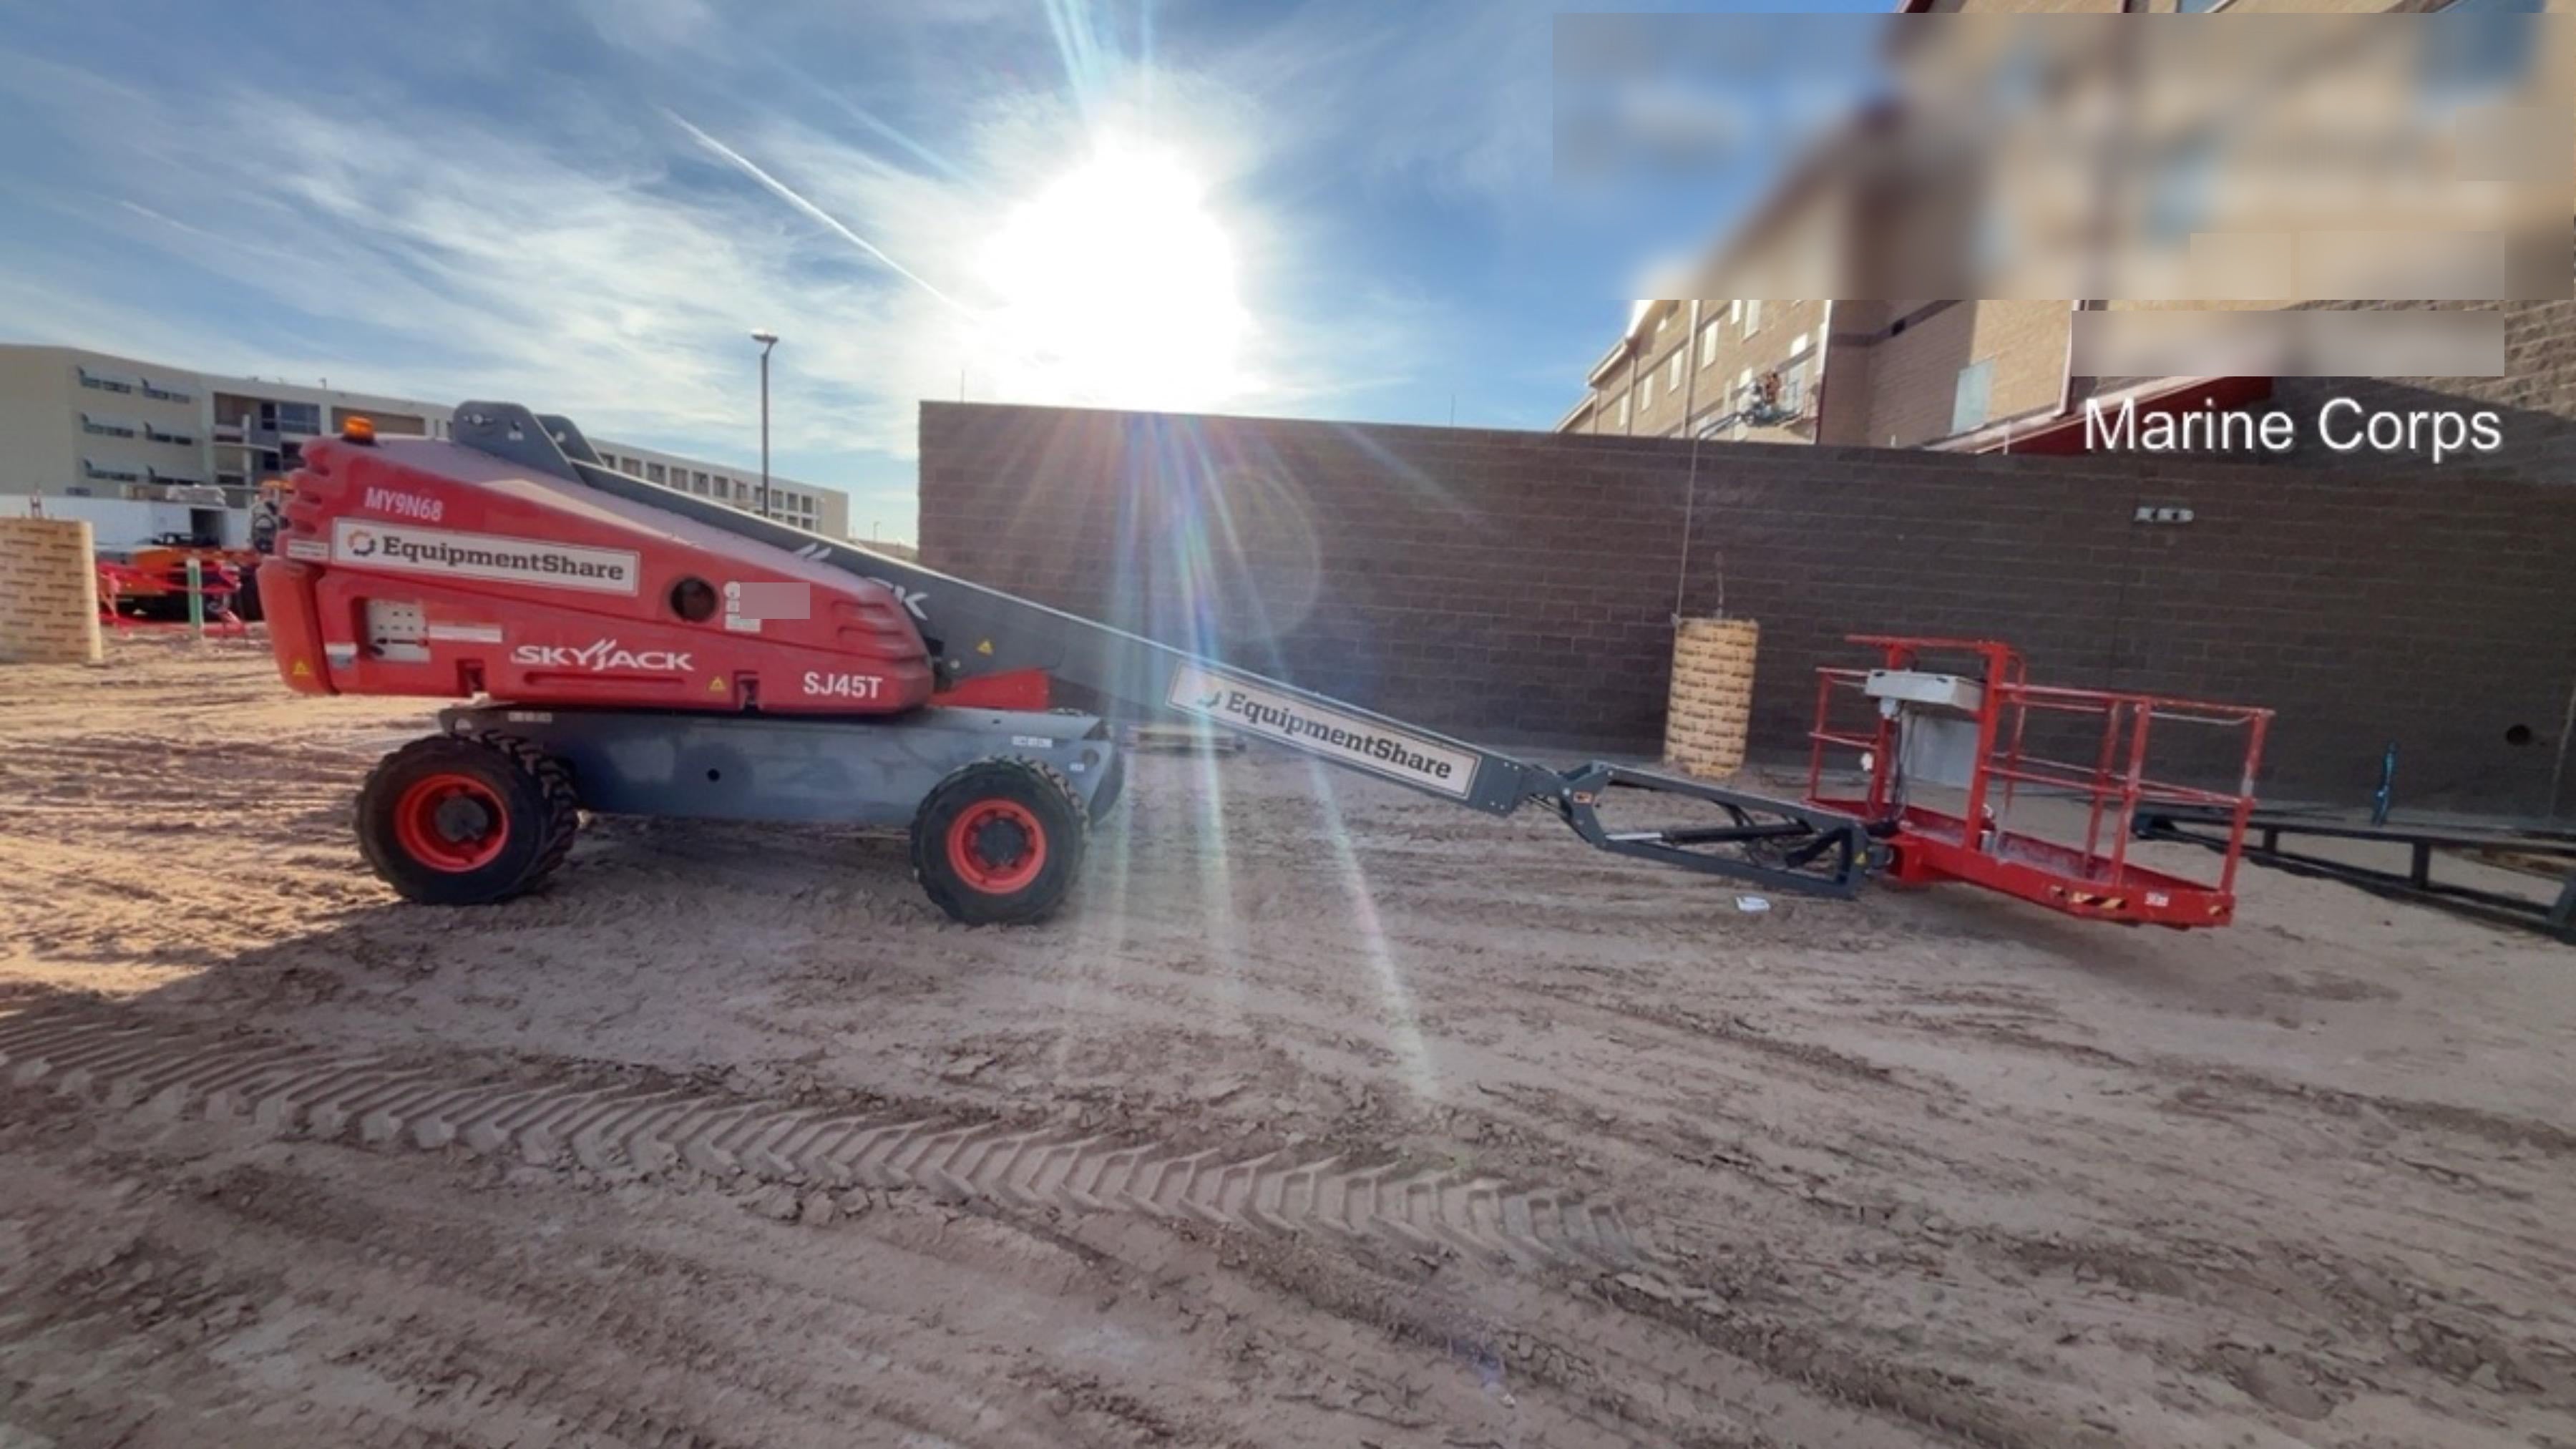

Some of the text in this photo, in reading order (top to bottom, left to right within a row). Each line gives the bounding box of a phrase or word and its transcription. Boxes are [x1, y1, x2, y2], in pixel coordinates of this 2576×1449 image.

[364, 486, 444, 522] MY9N68
[382, 535, 625, 581] EquipmentShare
[510, 638, 696, 672] SKYJACK
[803, 670, 884, 699] SJ45T
[1225, 691, 1453, 779] EquipmentShare
